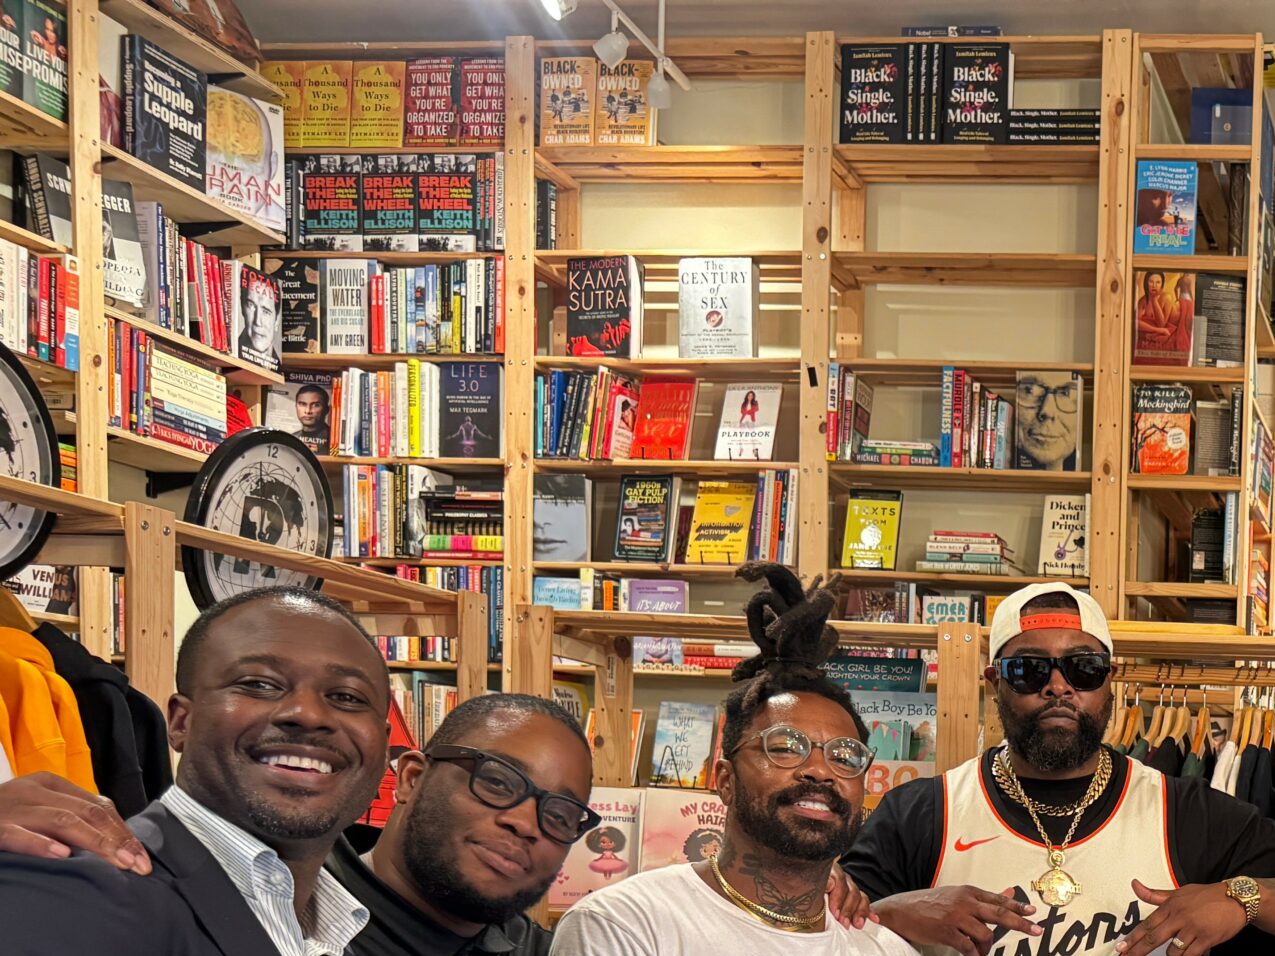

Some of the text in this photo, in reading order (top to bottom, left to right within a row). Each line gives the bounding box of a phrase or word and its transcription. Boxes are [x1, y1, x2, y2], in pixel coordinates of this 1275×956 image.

[26, 41, 49, 63] LIVE
[275, 66, 281, 75] A
[321, 66, 329, 75] A
[374, 67, 381, 75] A
[543, 61, 580, 74] BLACK-
[411, 72, 451, 83] YOU ONLY
[467, 73, 483, 83] YOU
[851, 68, 893, 82] Black.
[954, 67, 998, 81] Black.
[354, 79, 401, 88] Thousand
[543, 76, 582, 89] OWNED
[599, 77, 639, 90] OWNED
[144, 72, 194, 114] Supple
[312, 90, 337, 101] Ways
[364, 91, 389, 101] Ways
[410, 86, 452, 96] GET WHAT
[466, 87, 482, 96] GET
[847, 89, 894, 104] Single.
[124, 62, 135, 133] Supple Leopard
[951, 88, 999, 106] Single.
[309, 103, 339, 112] to Die
[361, 104, 391, 112] to Die
[416, 100, 446, 109] YOU'RE
[471, 100, 503, 110] YOU'RE
[144, 97, 202, 140] Leopard
[407, 113, 454, 123] ORGANIZED
[844, 110, 897, 124] Mother.
[947, 109, 1002, 123] Mother.
[413, 125, 447, 135] TO TAKE
[469, 126, 504, 136] TO TAKE
[545, 134, 590, 144] CHAR ADAMS
[599, 134, 644, 144] CHAR ADAMS
[306, 176, 357, 187] BREAK
[364, 177, 413, 187] BREAK
[419, 176, 472, 187] BREAK
[306, 189, 335, 198] THE
[364, 189, 392, 198] THE
[419, 189, 449, 198] THE
[307, 200, 357, 210] WHEEL
[364, 200, 413, 210] WHEEL
[419, 200, 472, 210] WHEEL
[320, 211, 357, 220] KEITH
[377, 210, 413, 220] KEITH
[434, 210, 472, 220] KEITH
[306, 220, 357, 229] ELLISON
[364, 220, 414, 229] ELLISON
[420, 219, 472, 229] ELLISON
[571, 258, 626, 271] THE MODERN
[704, 260, 724, 271] The
[242, 268, 278, 294] TOTAL
[330, 269, 365, 287] MOVING
[569, 268, 627, 290] KAMA
[681, 272, 747, 285] CENTURY
[241, 278, 278, 303] RECALL
[709, 284, 720, 296] of
[332, 288, 361, 306] WATER
[569, 290, 628, 311] SUTRA
[700, 296, 728, 310] SEX
[330, 334, 365, 347] AMY GREEN
[451, 364, 488, 378] LIFE
[459, 381, 479, 392] 3.0
[953, 374, 962, 413] MURDLE
[942, 370, 952, 433] FACTFULNESS
[1138, 399, 1190, 411] Mockingbird
[722, 430, 770, 438] PLAYBOOK
[267, 446, 279, 458] 12
[856, 454, 933, 465] MICHAEL CHABON
[626, 487, 668, 497] GAY PULP
[629, 496, 664, 505] FICTION
[853, 507, 896, 516] TEXTS
[1059, 512, 1080, 521] and
[1051, 521, 1086, 531] Prince
[310, 540, 316, 550] 3
[32, 569, 69, 586] VENUS
[636, 600, 680, 612] IT'S ABOUT
[847, 664, 913, 674] GIRL BE YOU!
[881, 700, 922, 716] Boy Be
[675, 734, 688, 742] WE
[680, 802, 698, 817] MY
